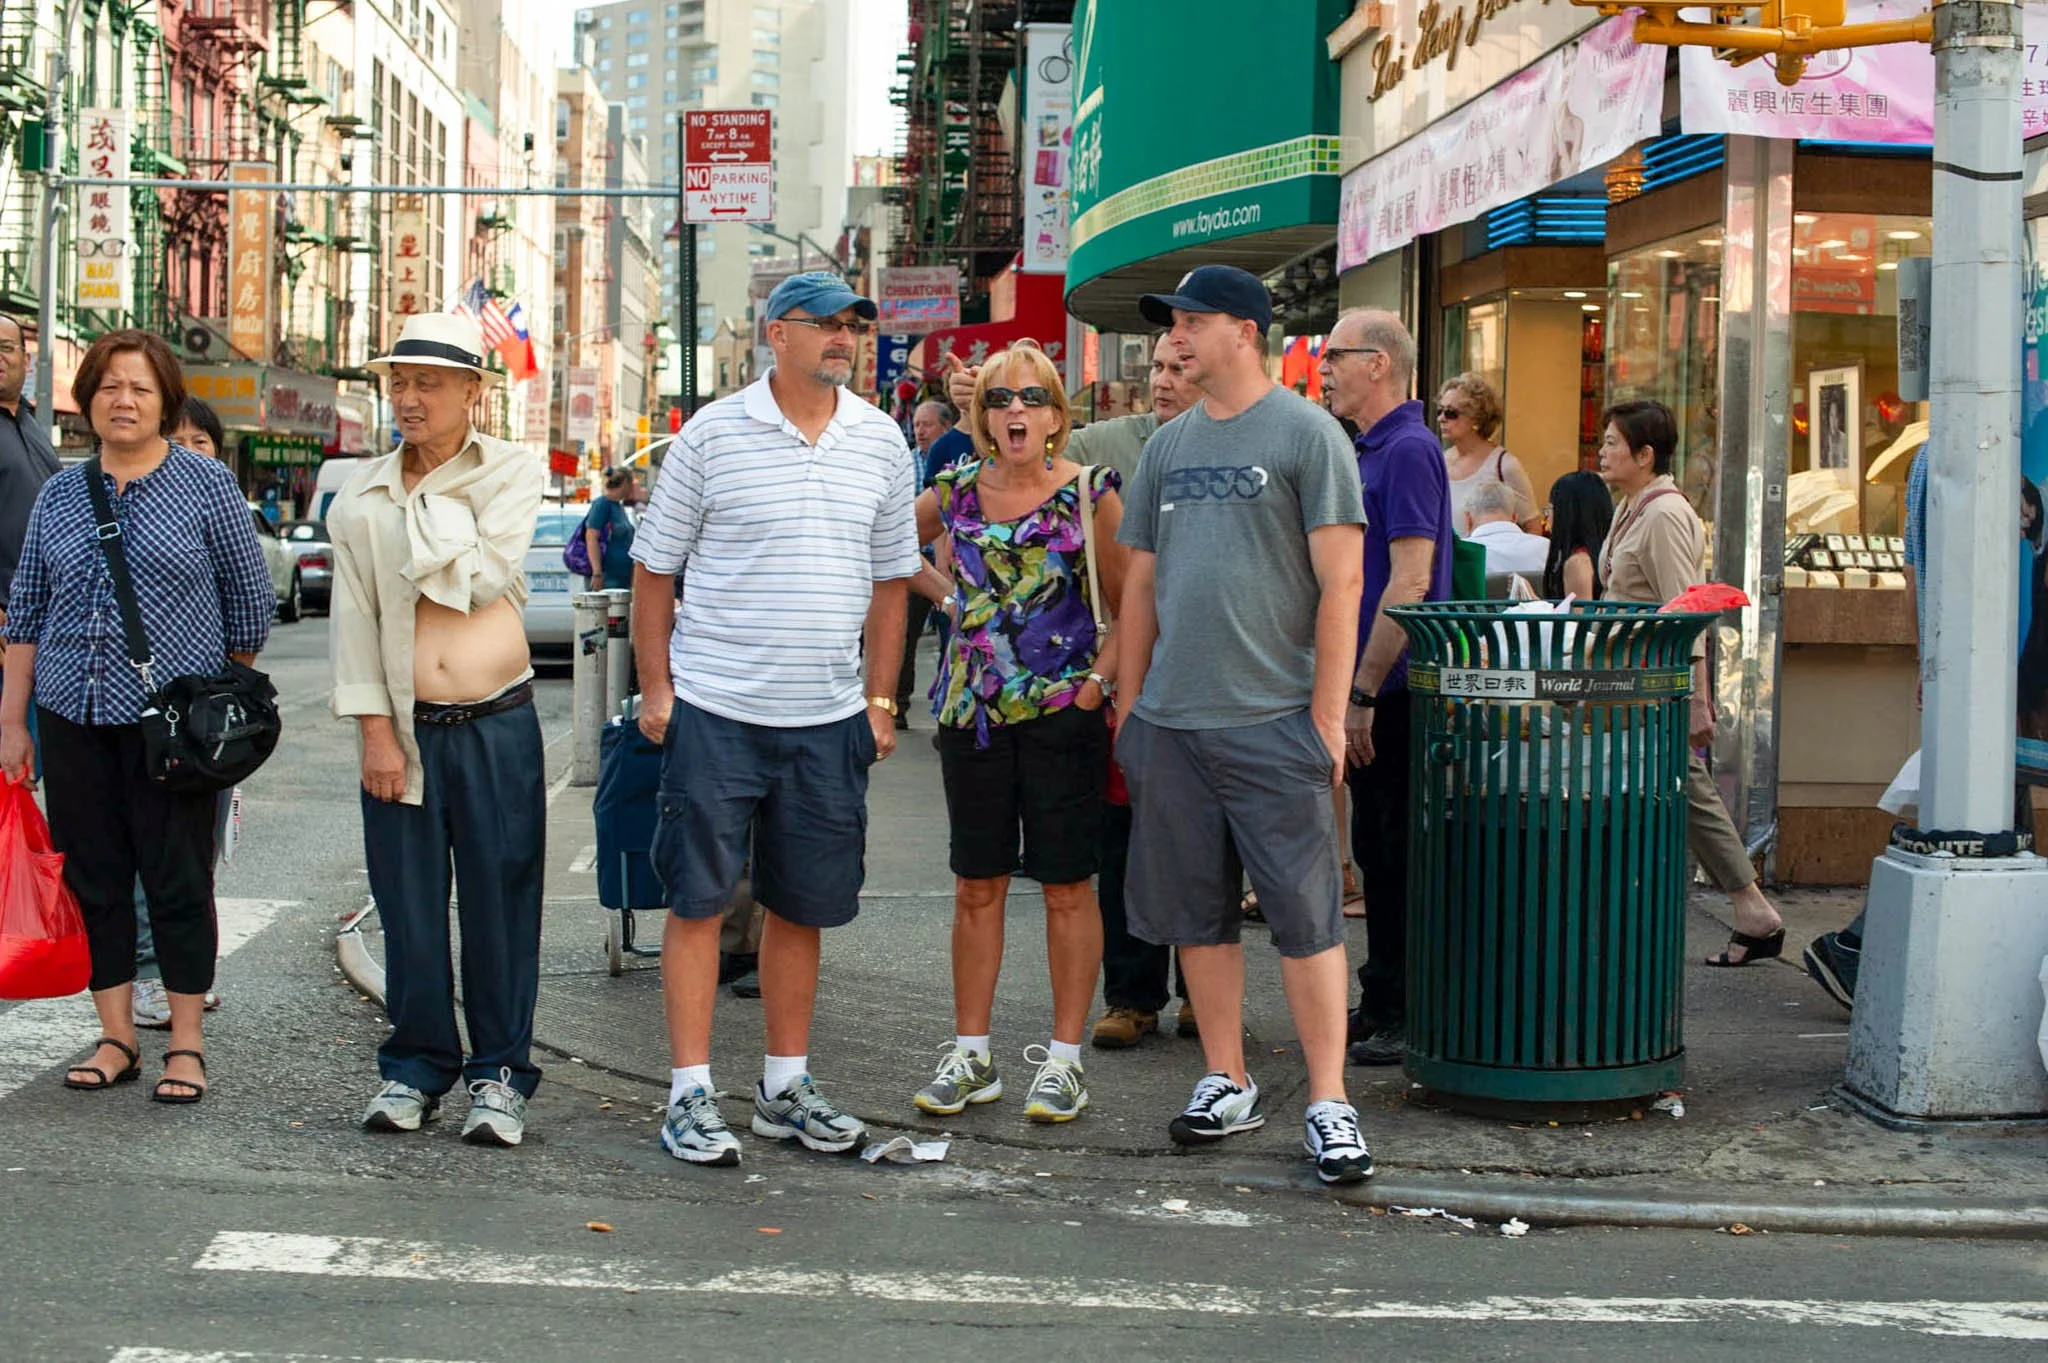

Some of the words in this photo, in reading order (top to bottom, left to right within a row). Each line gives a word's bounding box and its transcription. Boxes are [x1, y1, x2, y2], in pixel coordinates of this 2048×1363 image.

[1727, 87, 1889, 119] 麗興恆生集團
[691, 114, 706, 127] NO
[711, 113, 766, 126] STANDING
[687, 168, 710, 188] NO
[712, 173, 768, 184] PARKING
[700, 192, 757, 204] ANYTIME
[1172, 204, 1261, 238] www.fayda.com
[885, 284, 952, 296] CHINATOWN
[1446, 673, 1528, 691] 世界日報
[1540, 677, 1582, 692] World
[1584, 677, 1636, 693] Journal
